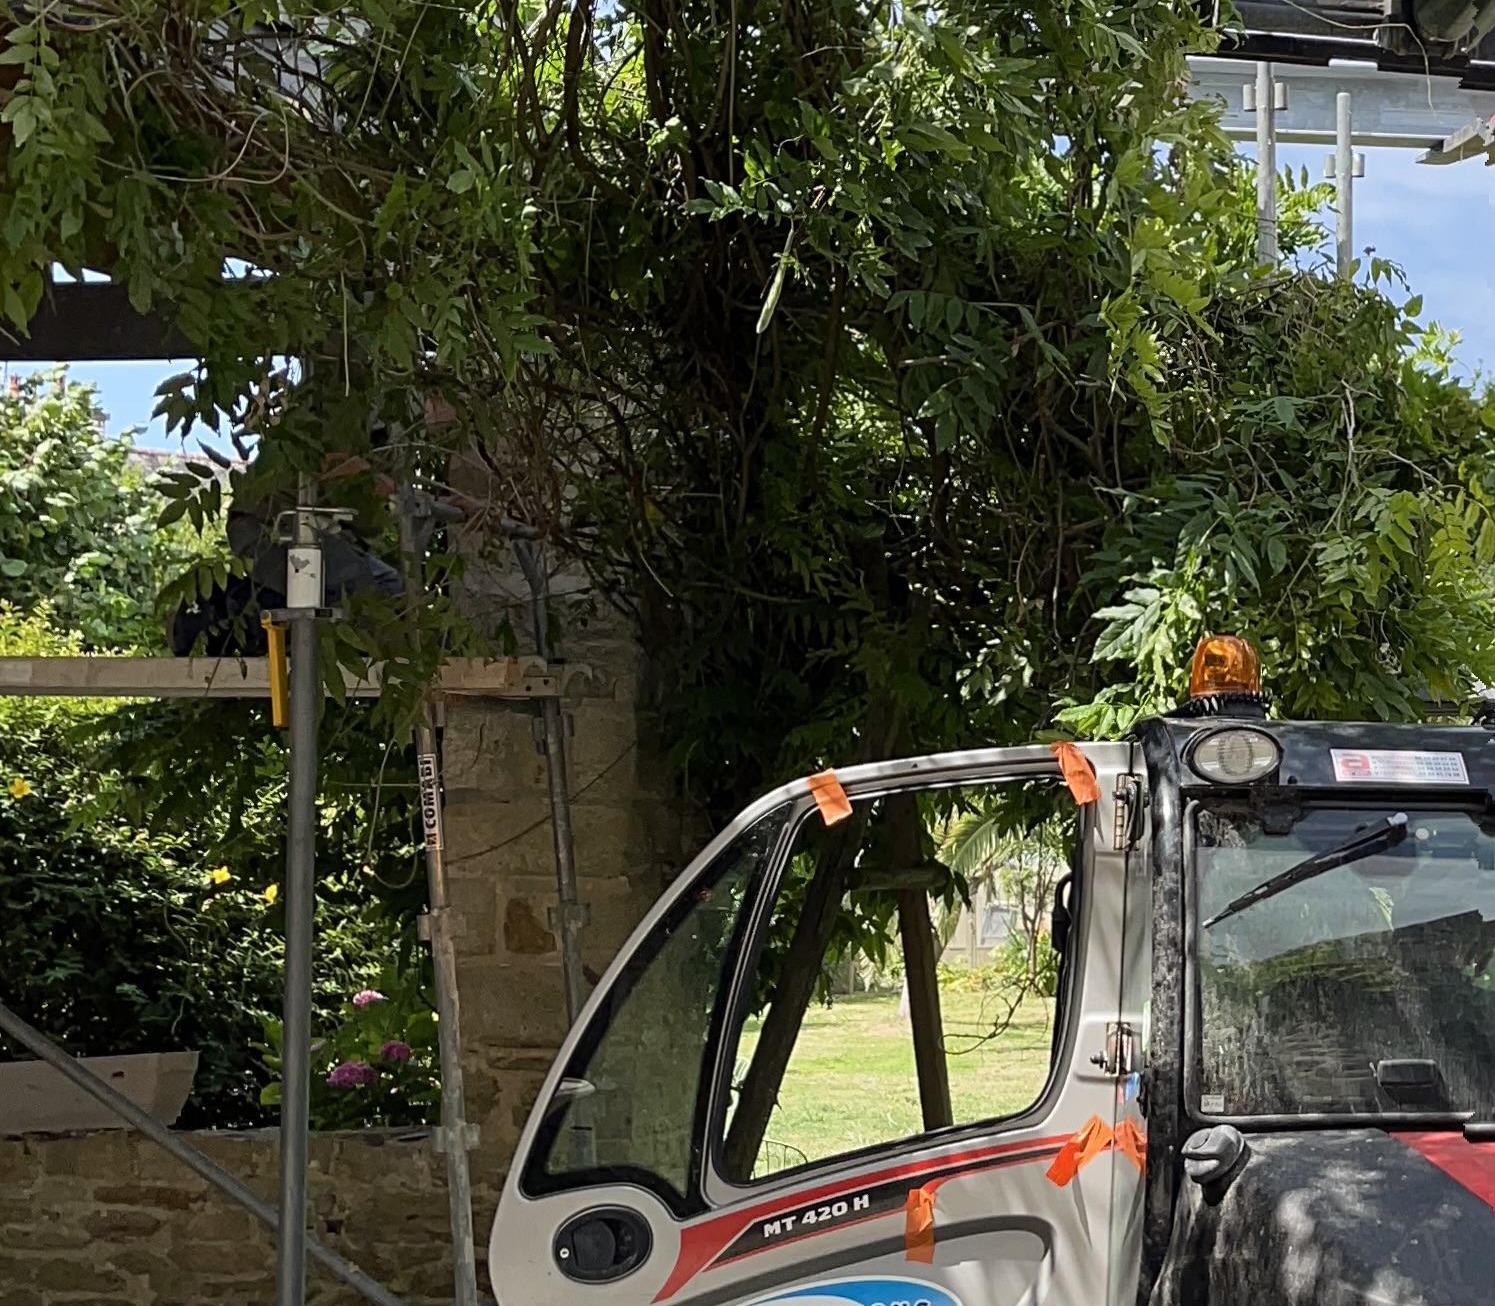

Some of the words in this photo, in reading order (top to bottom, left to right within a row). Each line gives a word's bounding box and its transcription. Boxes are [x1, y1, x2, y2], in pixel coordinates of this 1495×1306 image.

[763, 1215, 796, 1238] MT
[802, 1201, 851, 1226] 420
[853, 1194, 871, 1211] H
